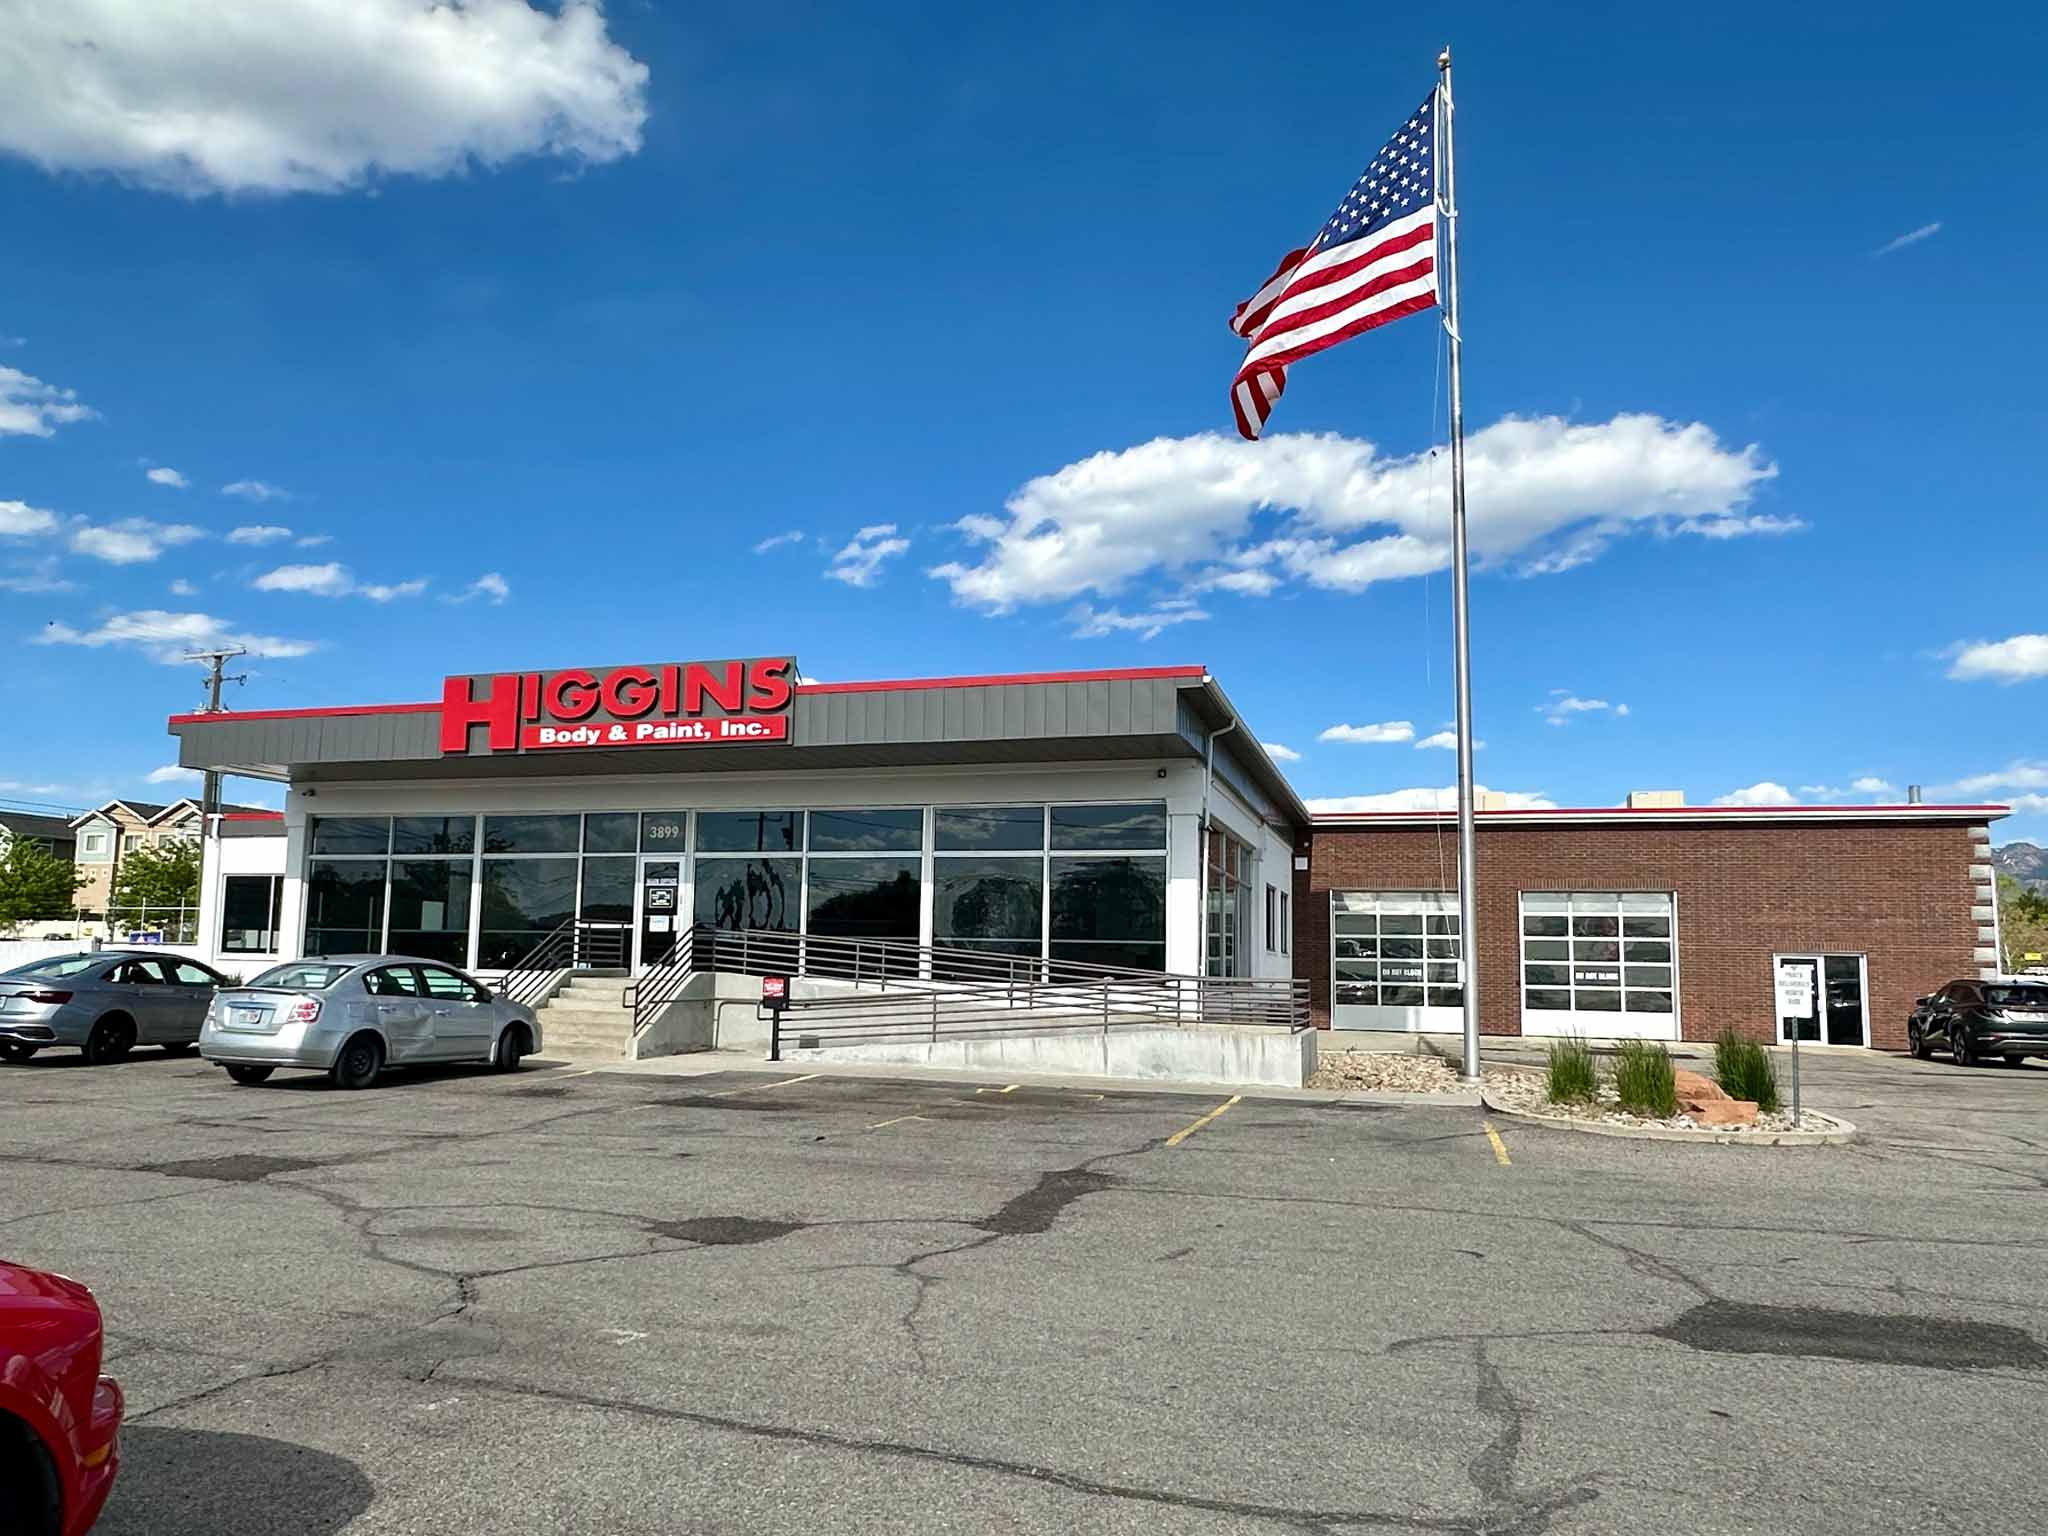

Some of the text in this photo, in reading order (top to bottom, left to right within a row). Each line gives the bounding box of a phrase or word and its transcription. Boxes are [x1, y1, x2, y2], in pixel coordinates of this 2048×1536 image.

[439, 659, 791, 753] HIGGINS
[539, 719, 770, 746] Body & Paint, Inc.
[649, 826, 680, 839] 3899
